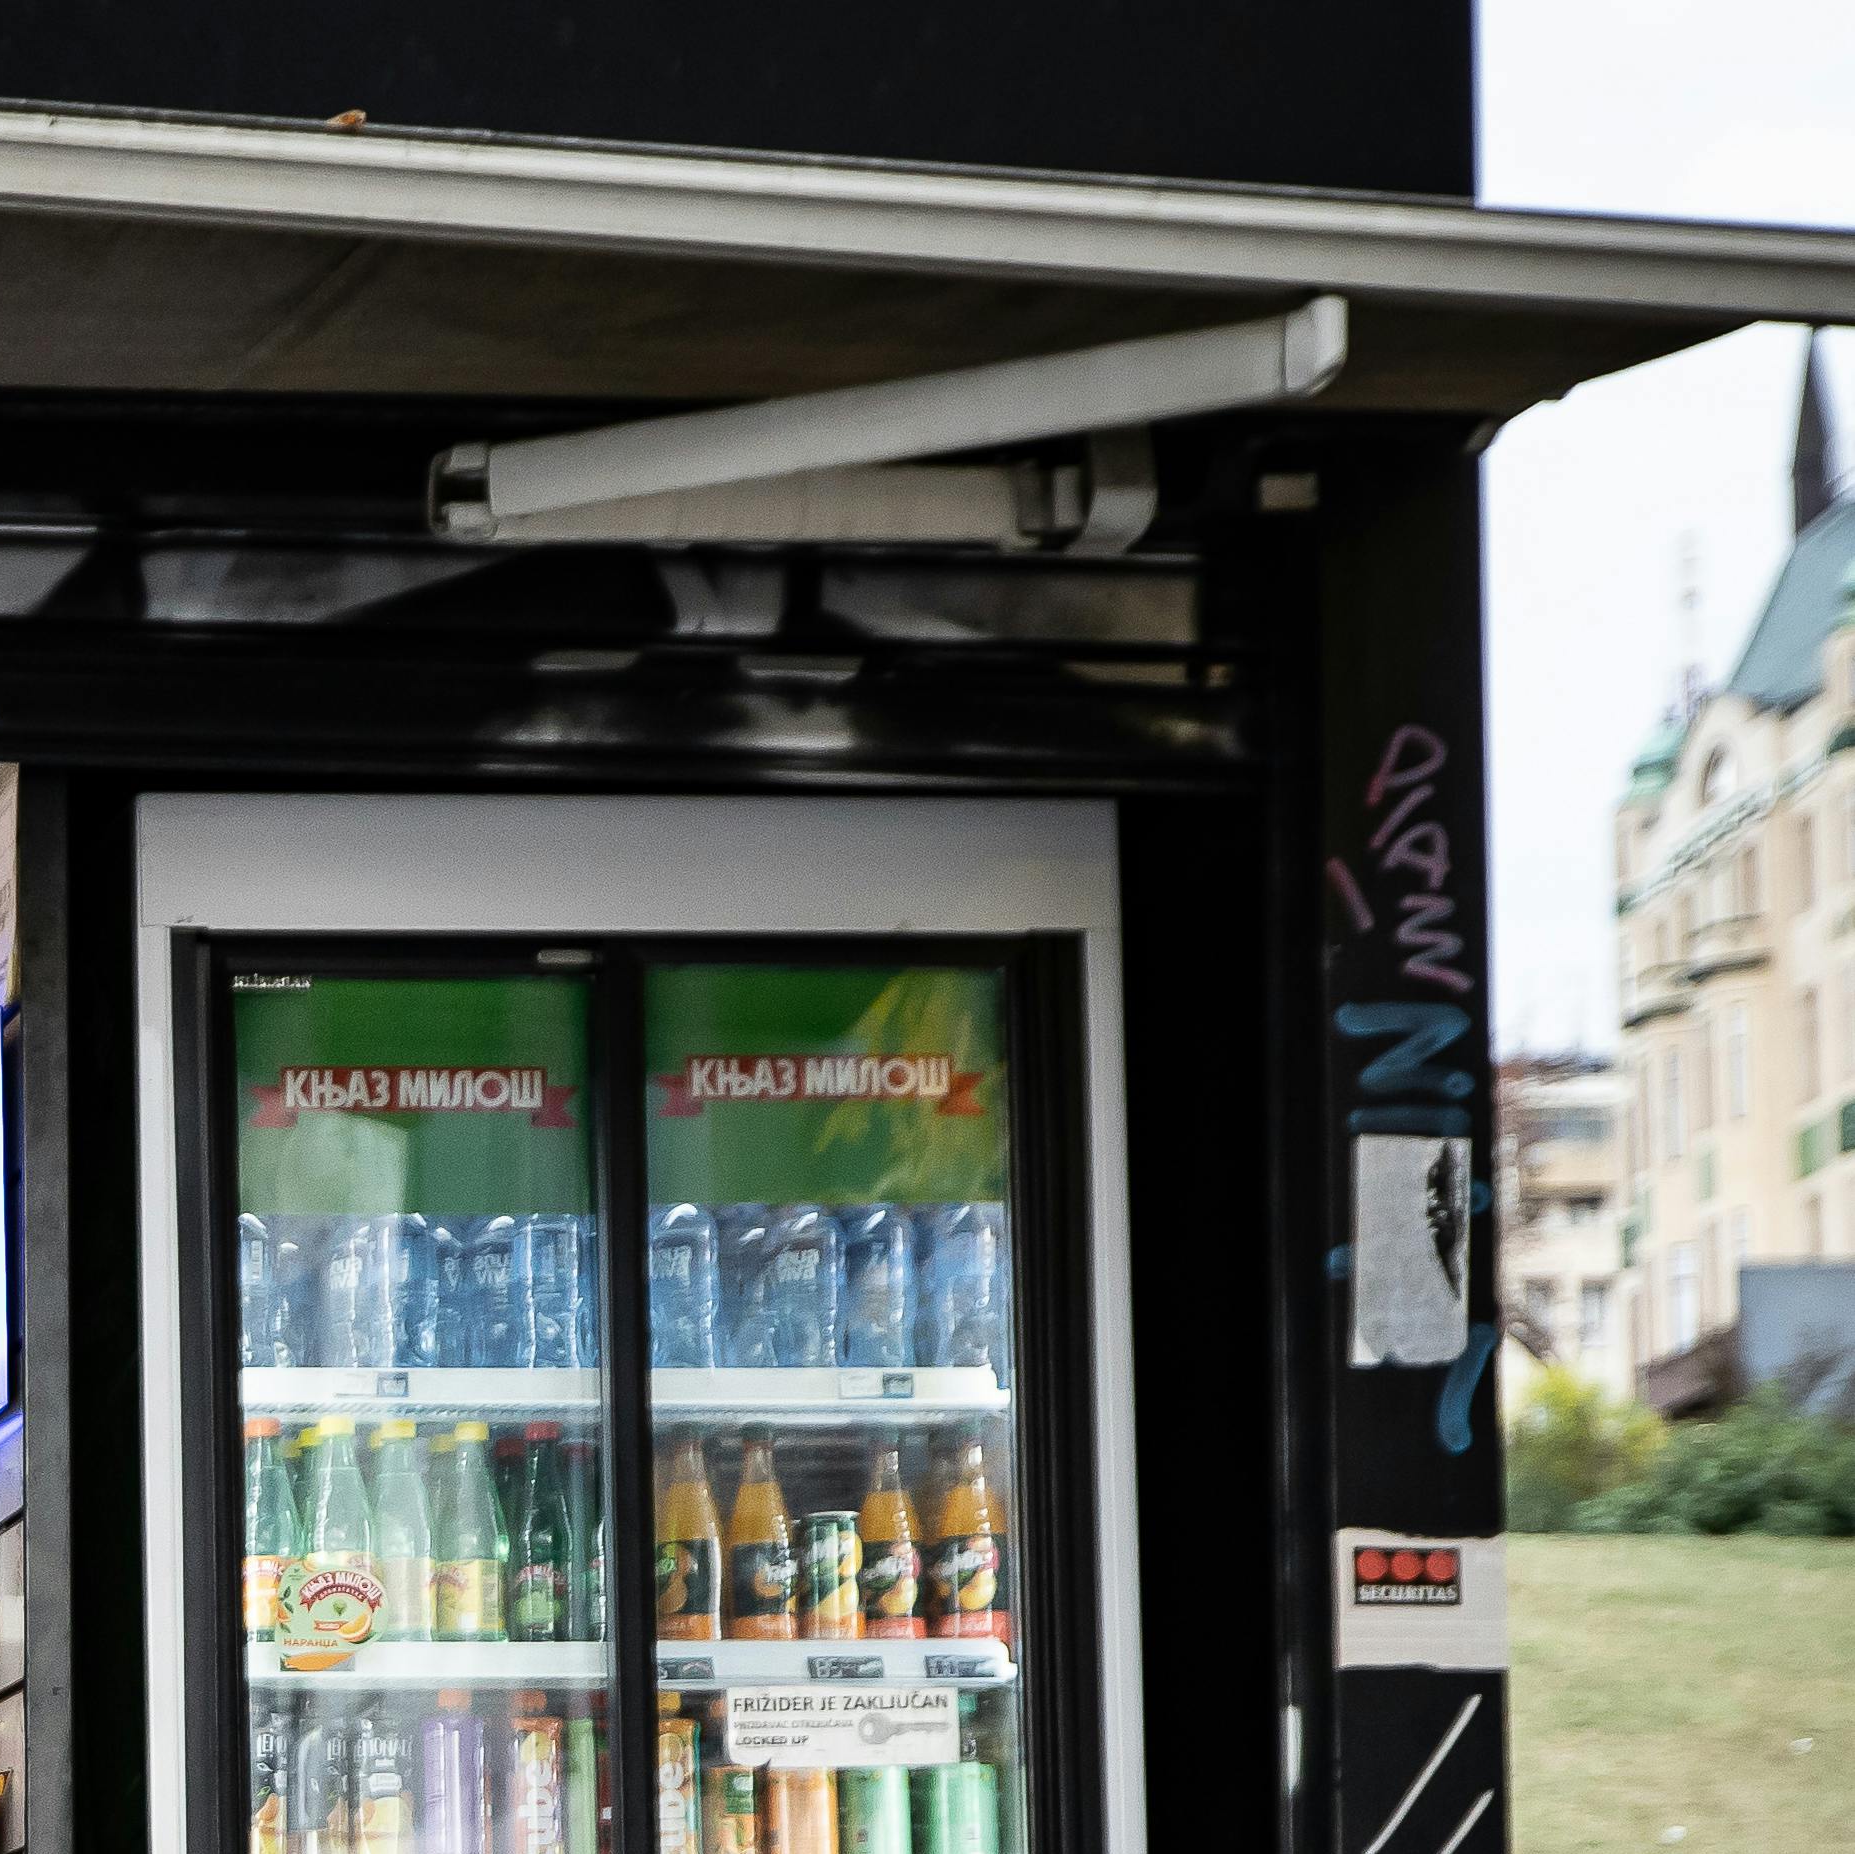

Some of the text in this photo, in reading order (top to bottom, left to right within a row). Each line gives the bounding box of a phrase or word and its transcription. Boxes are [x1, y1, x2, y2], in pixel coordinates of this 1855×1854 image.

[281, 1069, 546, 1110] КЊАЗ МИЛОШ
[689, 1056, 952, 1098] КЊАЗ МИЛОШ
[335, 1571, 382, 1601] МИЛОШ
[1356, 1582, 1458, 1603] SECURITAS
[733, 1691, 949, 1712] FRIŽIDER JE ZAKLJUČAN
[735, 1735, 808, 1746] LOCKED UP
